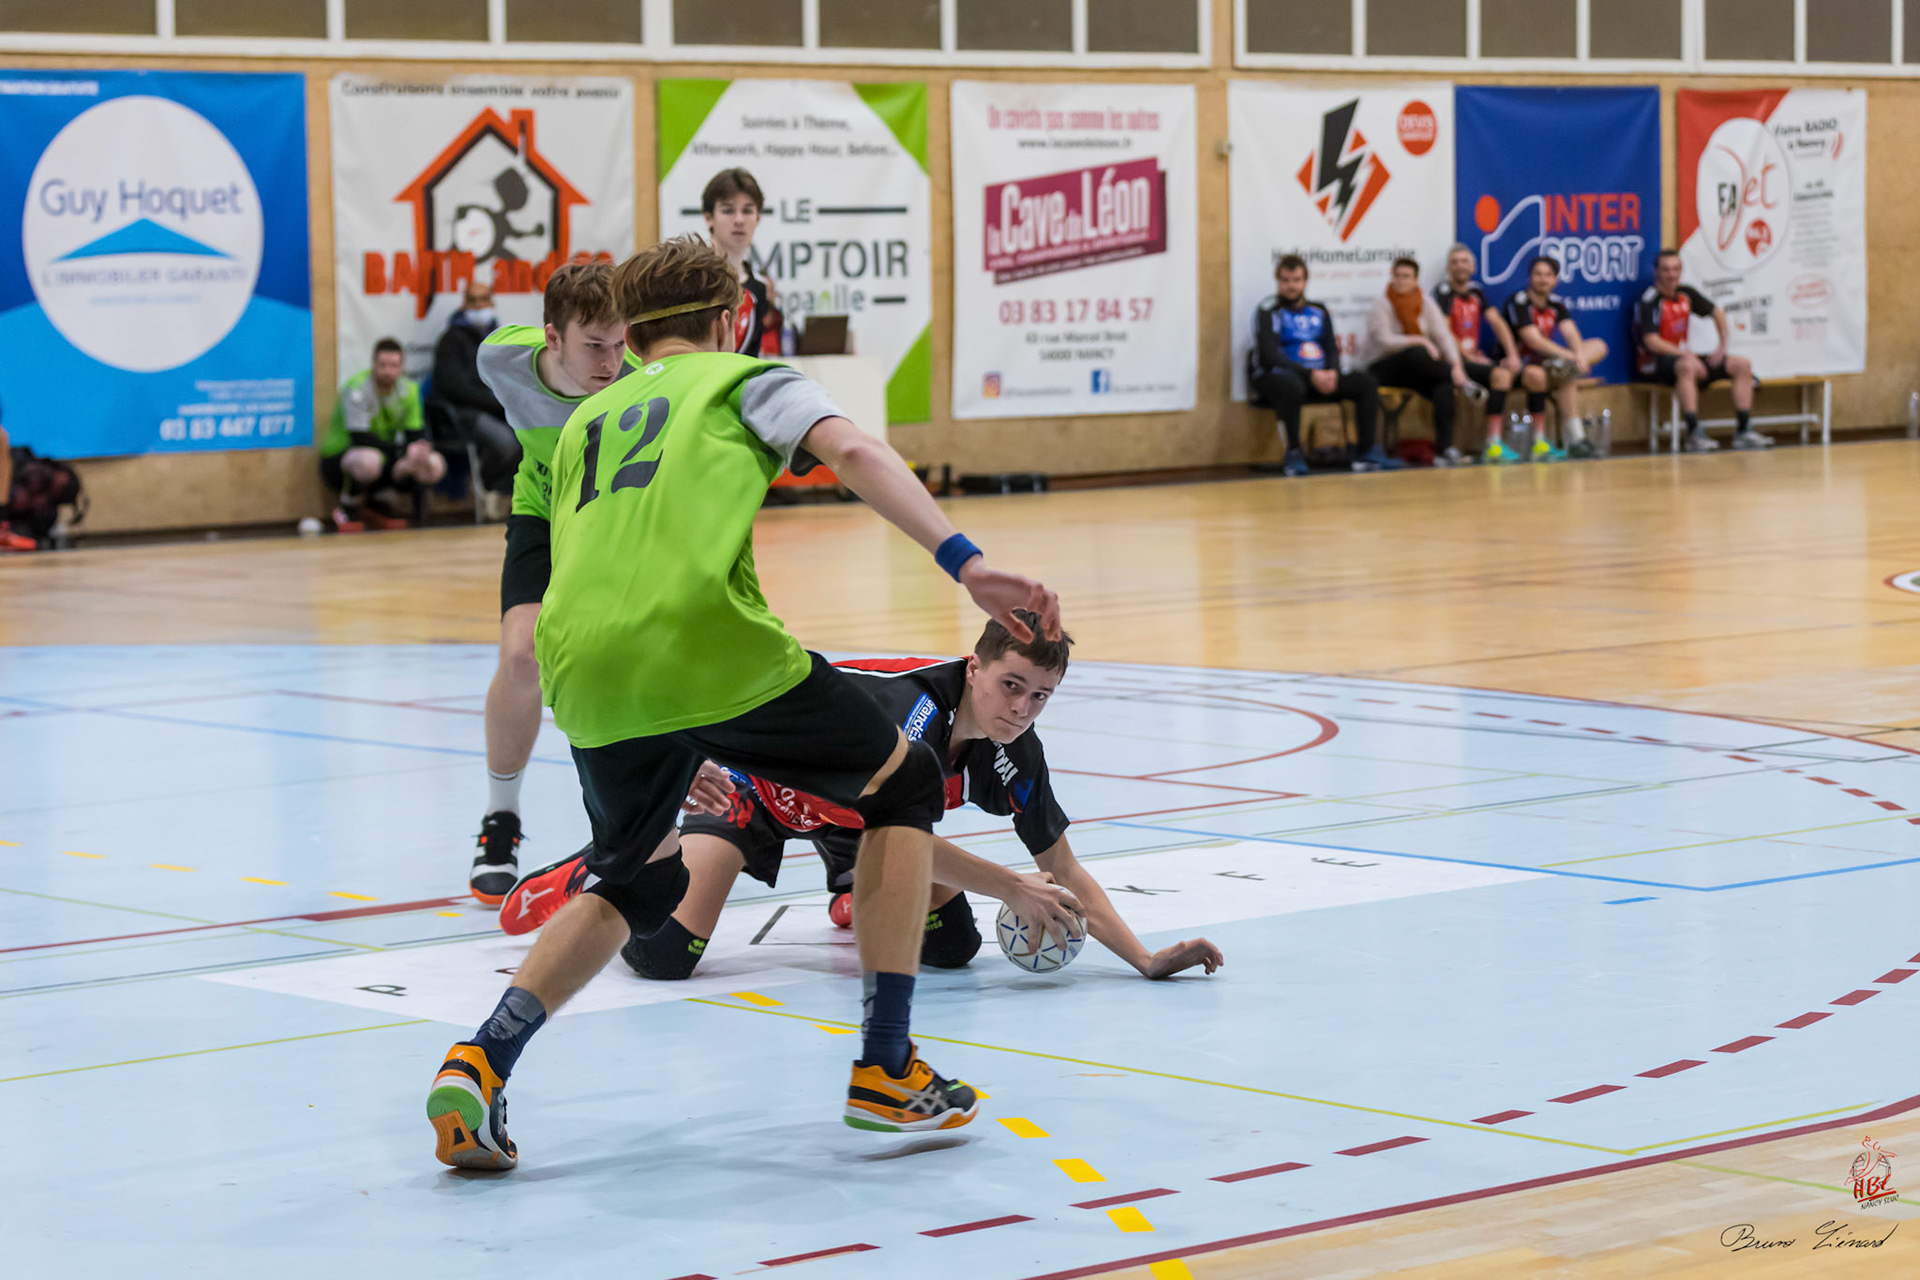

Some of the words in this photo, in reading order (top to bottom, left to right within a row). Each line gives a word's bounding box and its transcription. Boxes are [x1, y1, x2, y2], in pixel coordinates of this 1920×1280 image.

[40, 178, 109, 223] Guy
[118, 179, 243, 222] Hoquet
[781, 199, 812, 223] LE
[1001, 184, 1065, 255] Cave
[1082, 167, 1150, 239] Léon
[1545, 193, 1641, 232] INTER
[751, 241, 908, 279] MPTOIR
[1541, 235, 1645, 284] SPORT
[999, 300, 1025, 324] 03
[1030, 300, 1057, 324] 83
[1065, 299, 1089, 323] 17
[1096, 299, 1122, 322] 84
[1128, 298, 1154, 321] 57
[575, 397, 670, 513] 12
